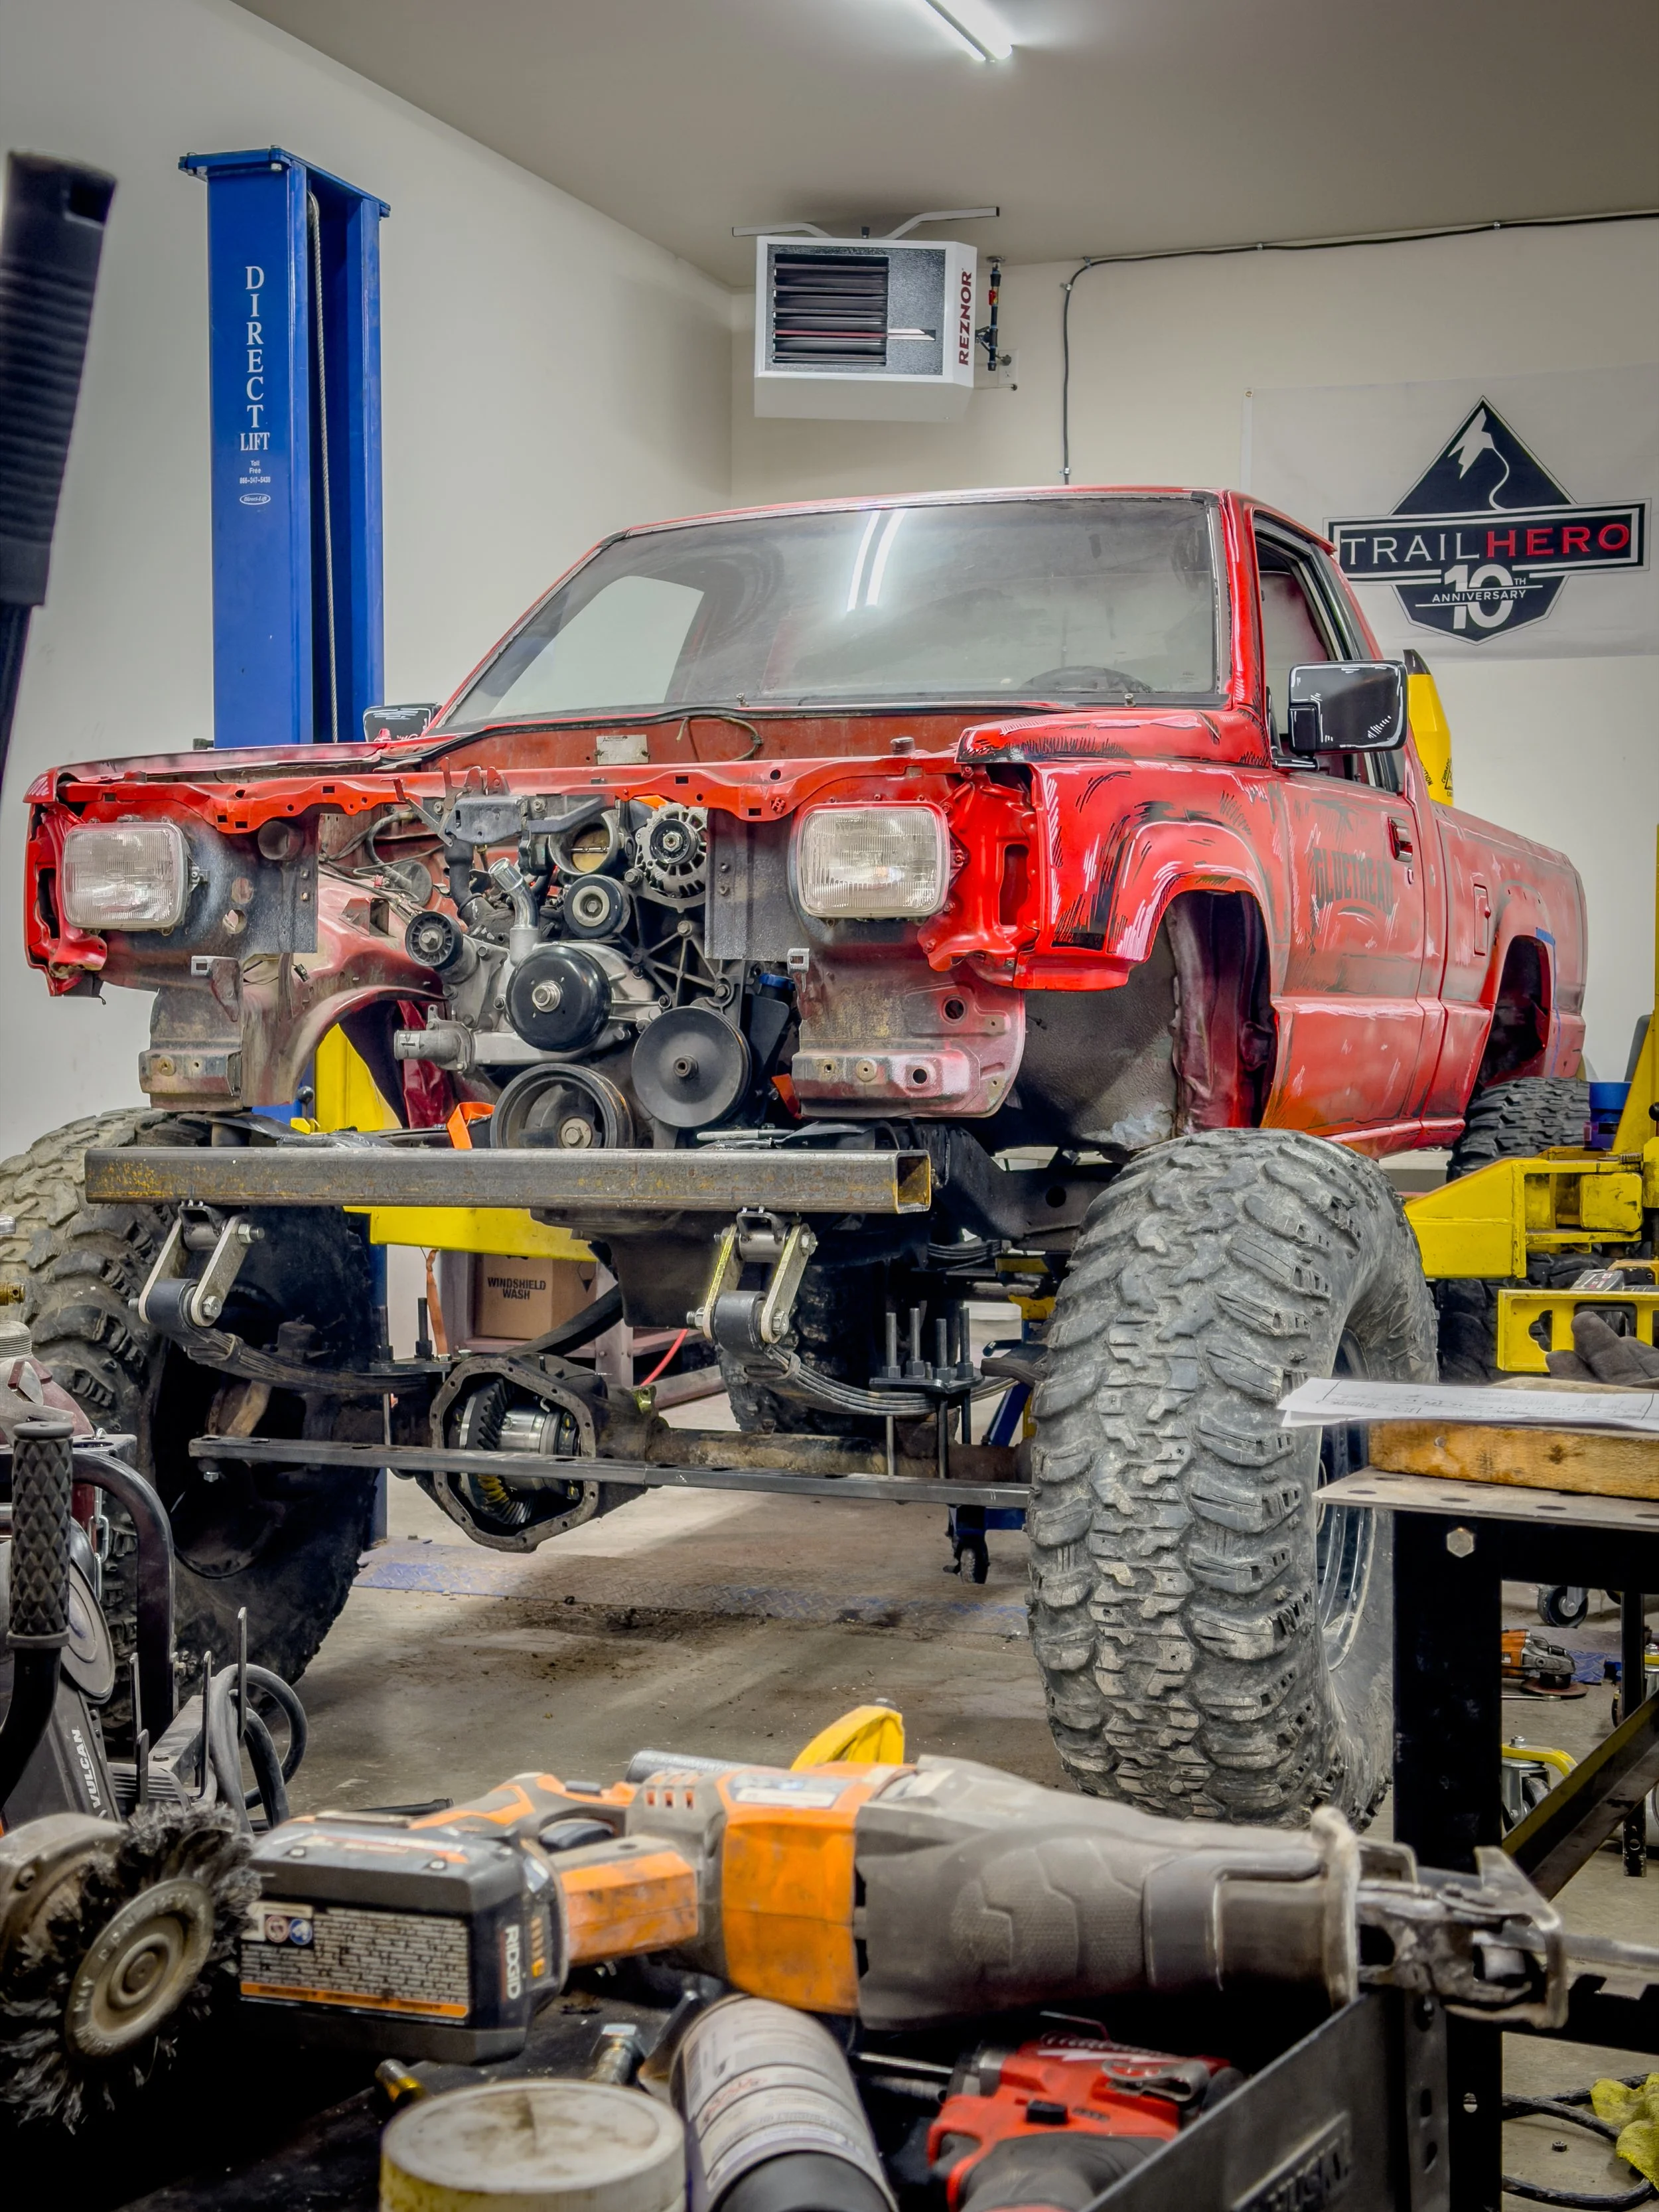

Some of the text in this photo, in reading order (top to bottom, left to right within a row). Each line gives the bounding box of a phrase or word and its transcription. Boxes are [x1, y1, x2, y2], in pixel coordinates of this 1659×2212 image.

[958, 272, 972, 365] REZNOR
[246, 266, 265, 428] DIRECT
[240, 432, 269, 451] LIFT
[1431, 589, 1527, 603] ANNIVERSARY
[487, 1277, 547, 1290] WINDSHIELD
[502, 1288, 530, 1299] WASH
[71, 1729, 101, 1808] VULCAN
[504, 1925, 521, 2000] RIDGID
